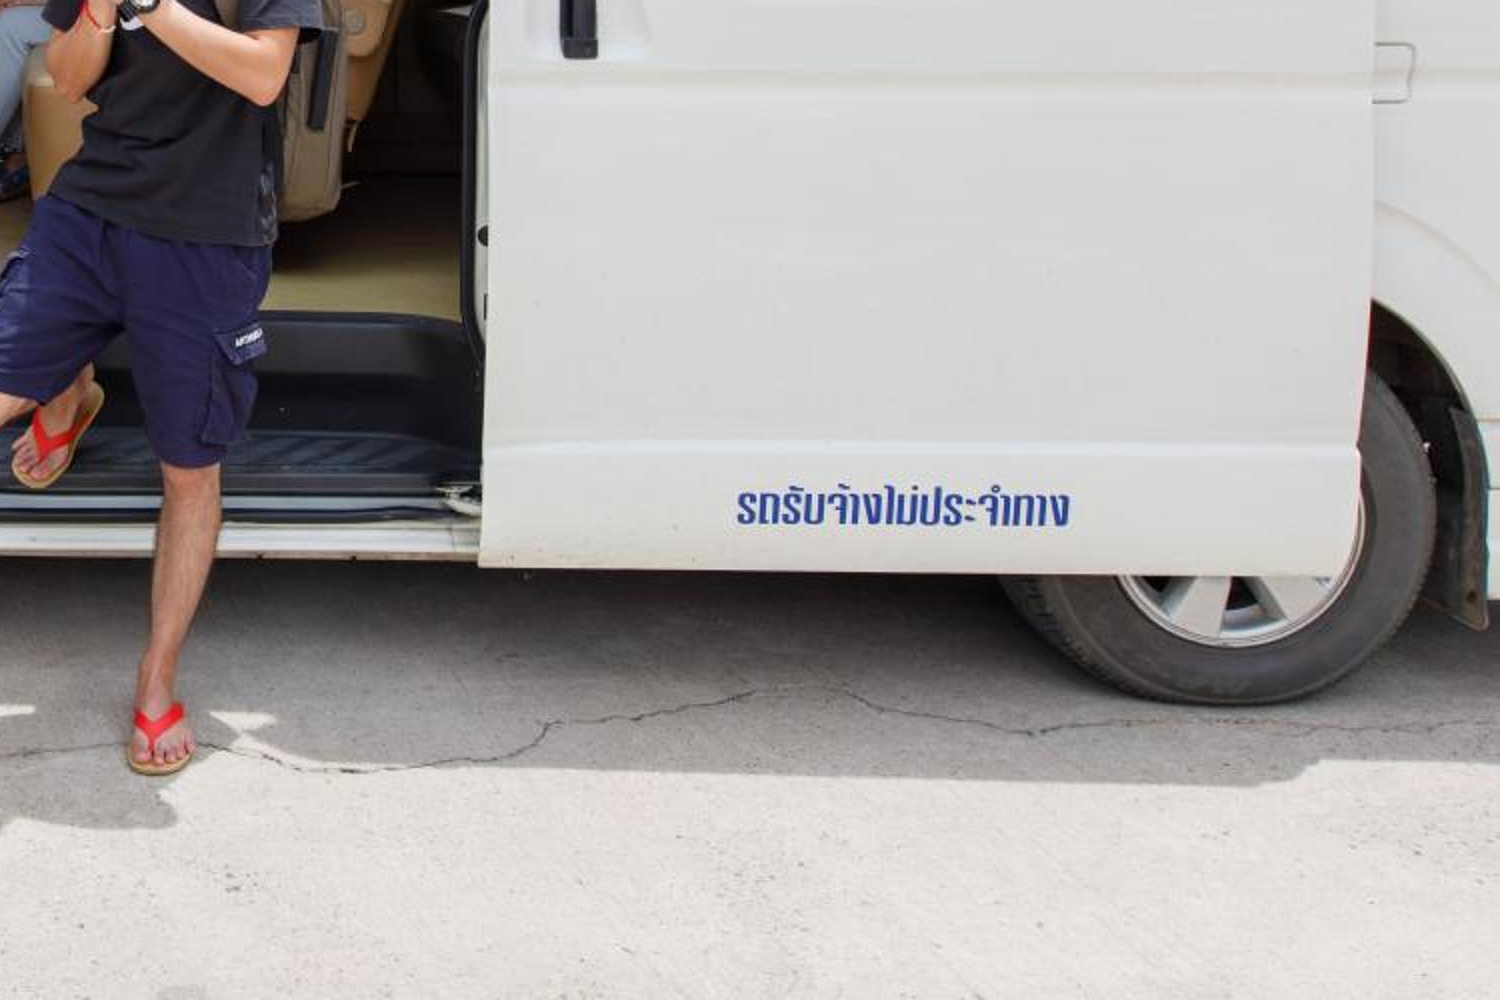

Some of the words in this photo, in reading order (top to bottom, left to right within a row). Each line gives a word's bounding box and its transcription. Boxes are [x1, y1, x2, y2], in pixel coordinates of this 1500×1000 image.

[736, 483, 1071, 527] รถรับจ้างไม่ประจำทาง
